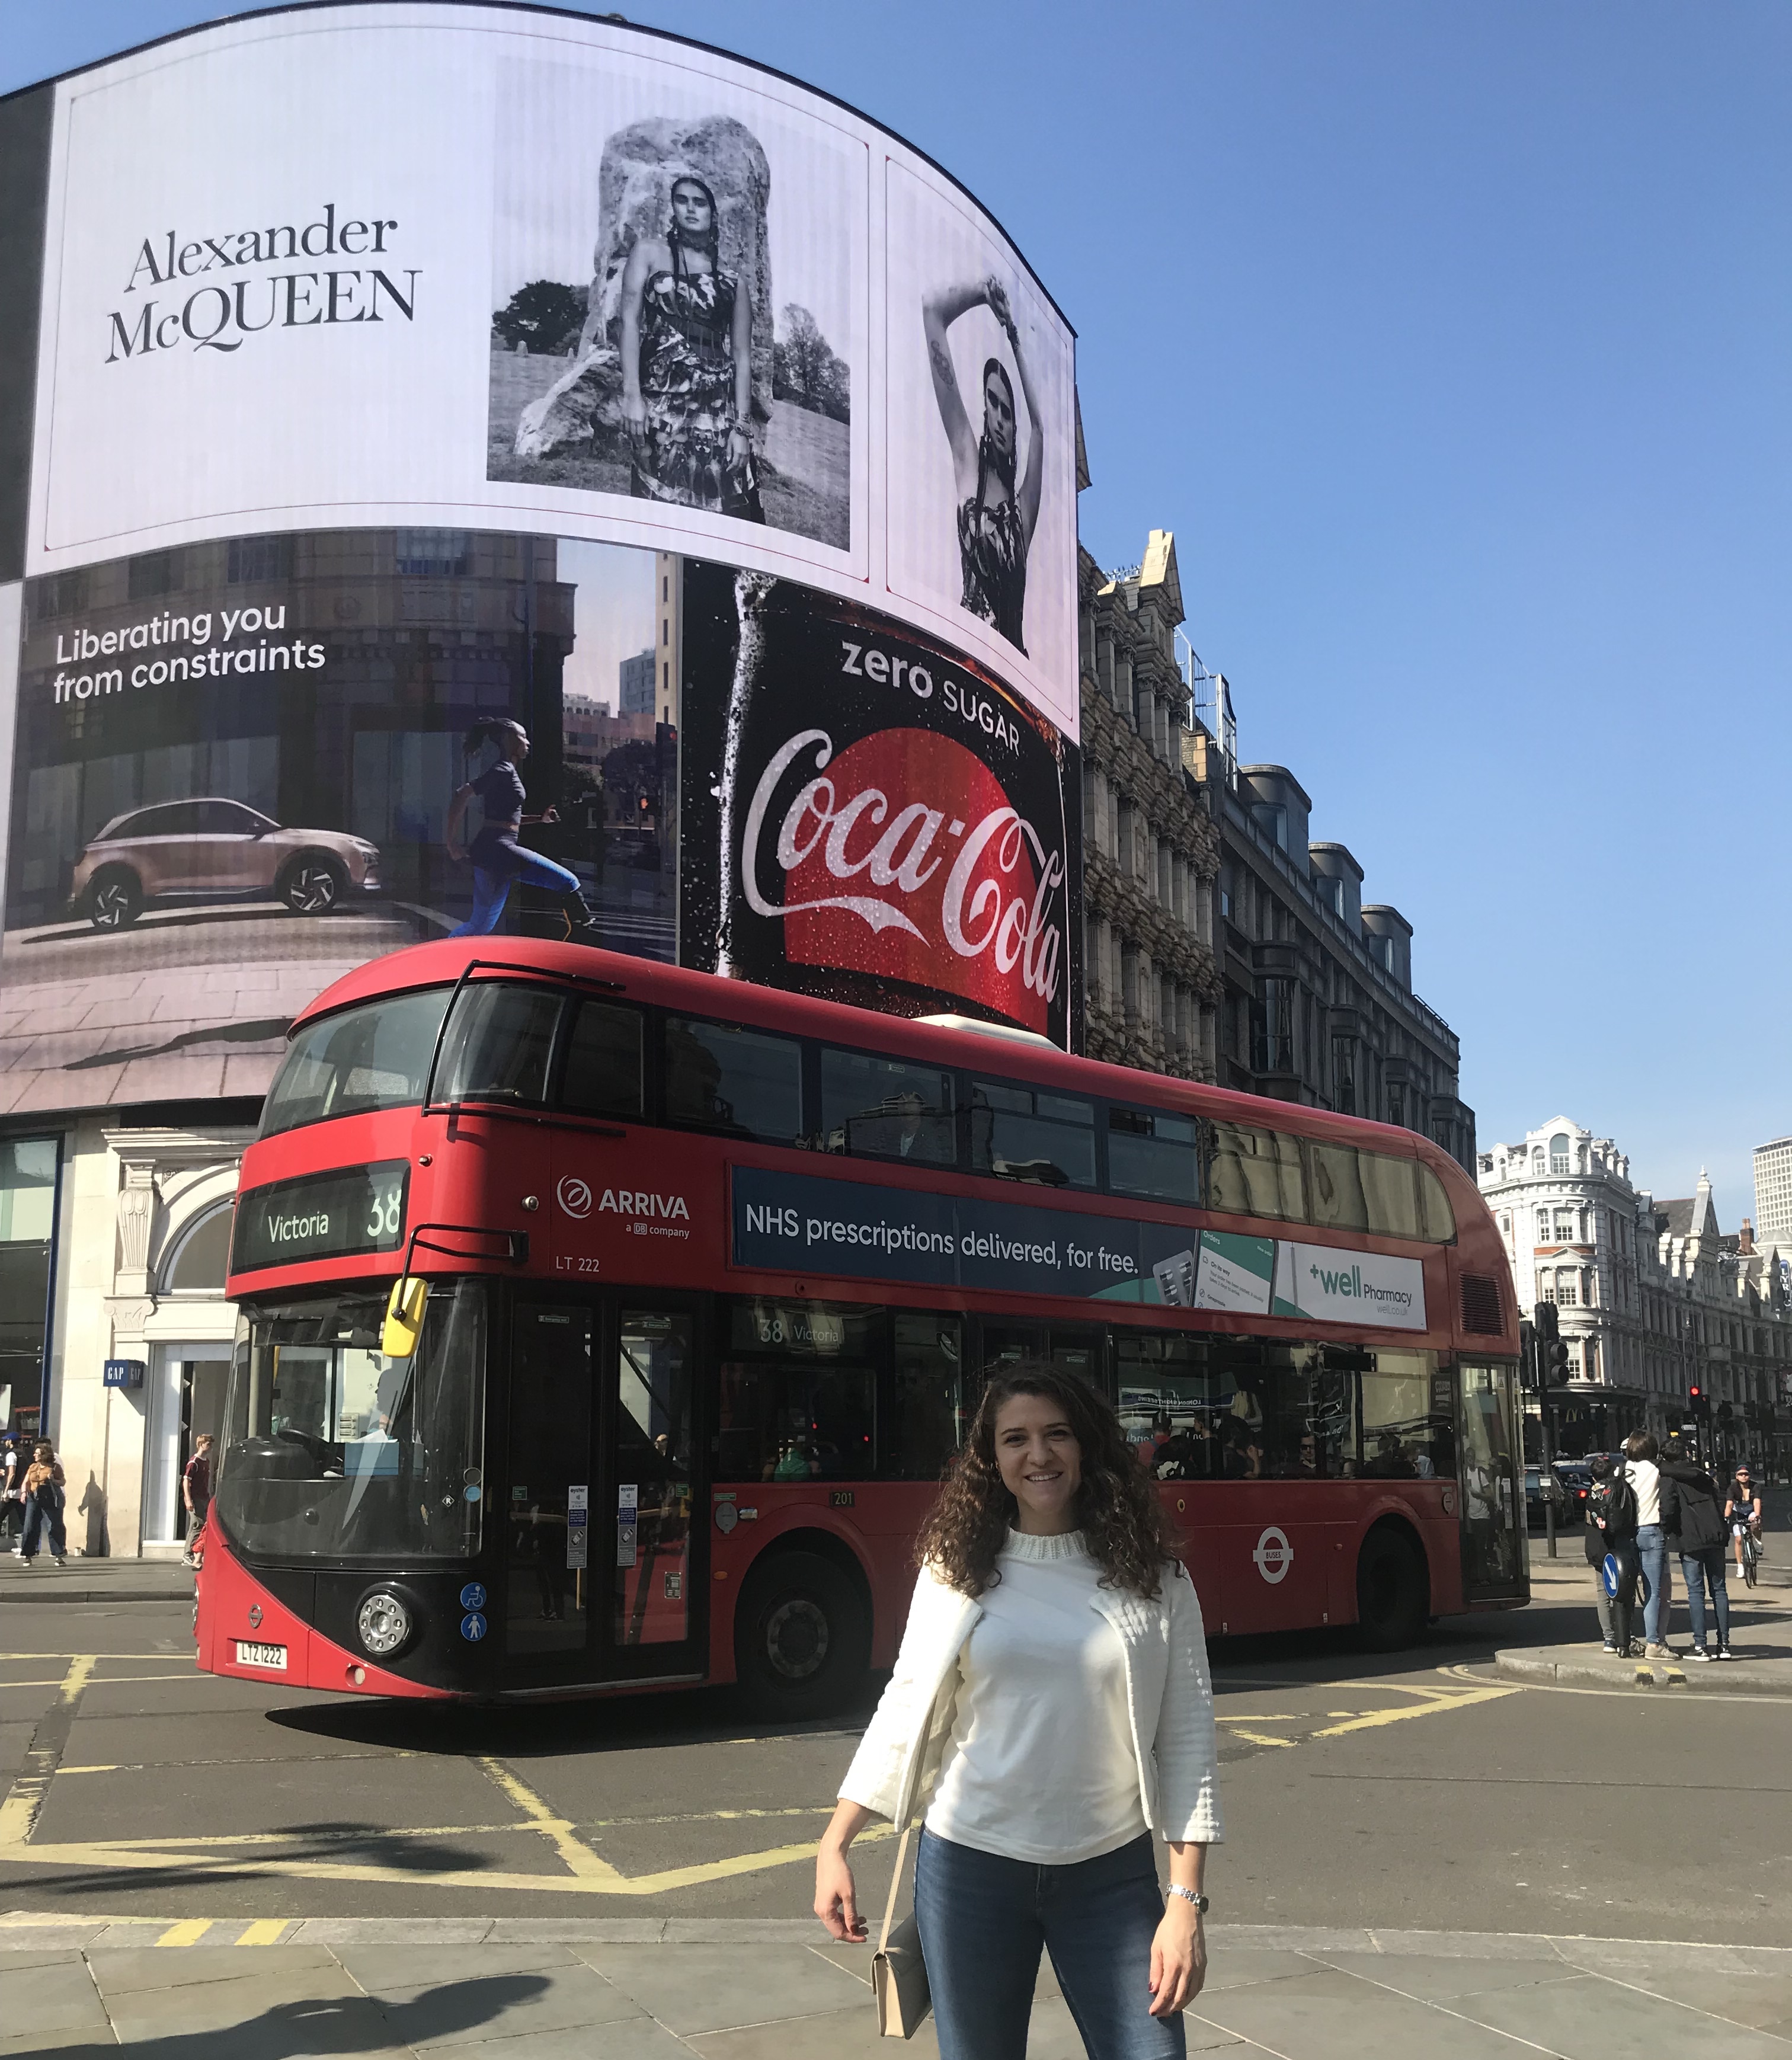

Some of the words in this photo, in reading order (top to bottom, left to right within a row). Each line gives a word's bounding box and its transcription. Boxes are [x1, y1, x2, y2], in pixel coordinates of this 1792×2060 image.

[124, 203, 398, 293] Alexander
[105, 270, 423, 364] McQUEEN
[57, 612, 212, 664] Liberating
[220, 606, 286, 642] you
[54, 669, 123, 703] from
[131, 639, 325, 688] constraints
[841, 640, 933, 698] zero
[943, 680, 1019, 755] SUGAR
[268, 1210, 329, 1242] Victoria
[367, 1183, 402, 1236] 38
[599, 1189, 690, 1220] ARRIVA
[635, 1224, 647, 1234] DB
[649, 1226, 690, 1239] company
[747, 1204, 799, 1237] NHS
[807, 1220, 954, 1254] prescriptions
[961, 1231, 1061, 1269] delivered,
[1067, 1243, 1094, 1268] for
[1098, 1246, 1138, 1274] free.
[1203, 1230, 1220, 1245] Orders
[556, 1256, 573, 1270] LT
[578, 1258, 600, 1272] 222
[1364, 1284, 1412, 1307] Pharmacy
[1780, 1268, 1791, 1307] LYRIC
[760, 1319, 783, 1343] 38
[793, 1325, 839, 1342] Victoria
[108, 1367, 124, 1380] GAP
[130, 1367, 140, 1380] GAP
[835, 1493, 852, 1505] 201
